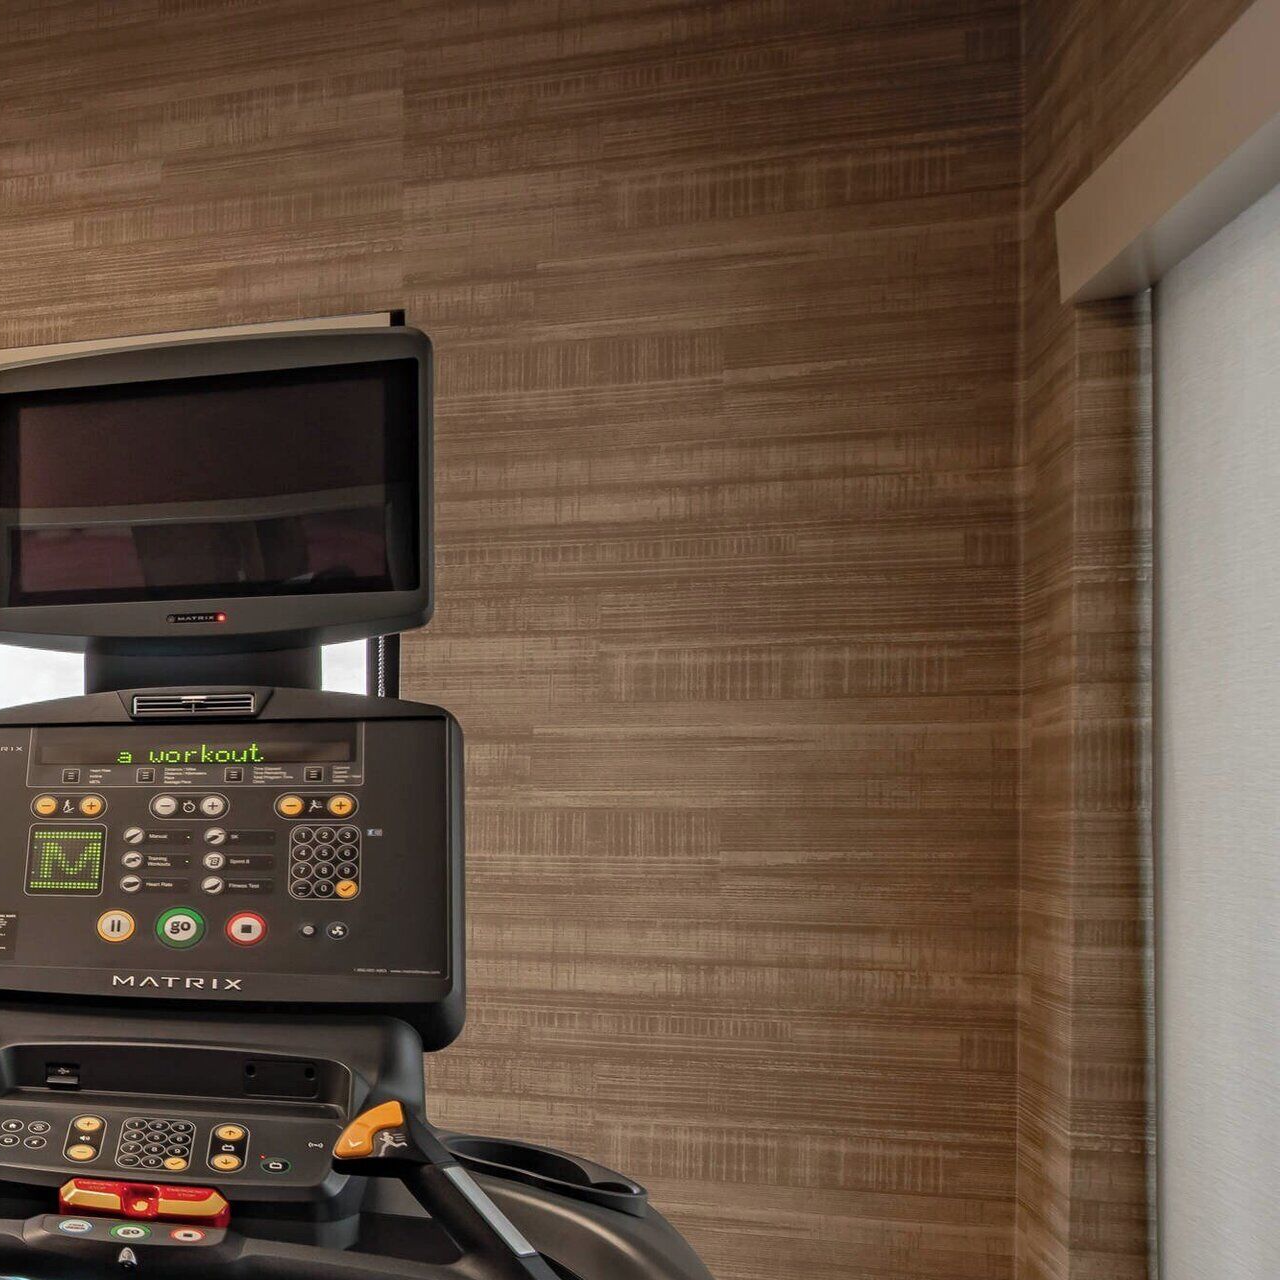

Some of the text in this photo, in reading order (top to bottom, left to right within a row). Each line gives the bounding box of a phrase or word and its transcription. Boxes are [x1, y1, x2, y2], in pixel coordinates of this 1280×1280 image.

[117, 743, 264, 763] a workout
[170, 920, 191, 934] go
[112, 974, 242, 991] MATRIX
[121, 1228, 140, 1237] go
